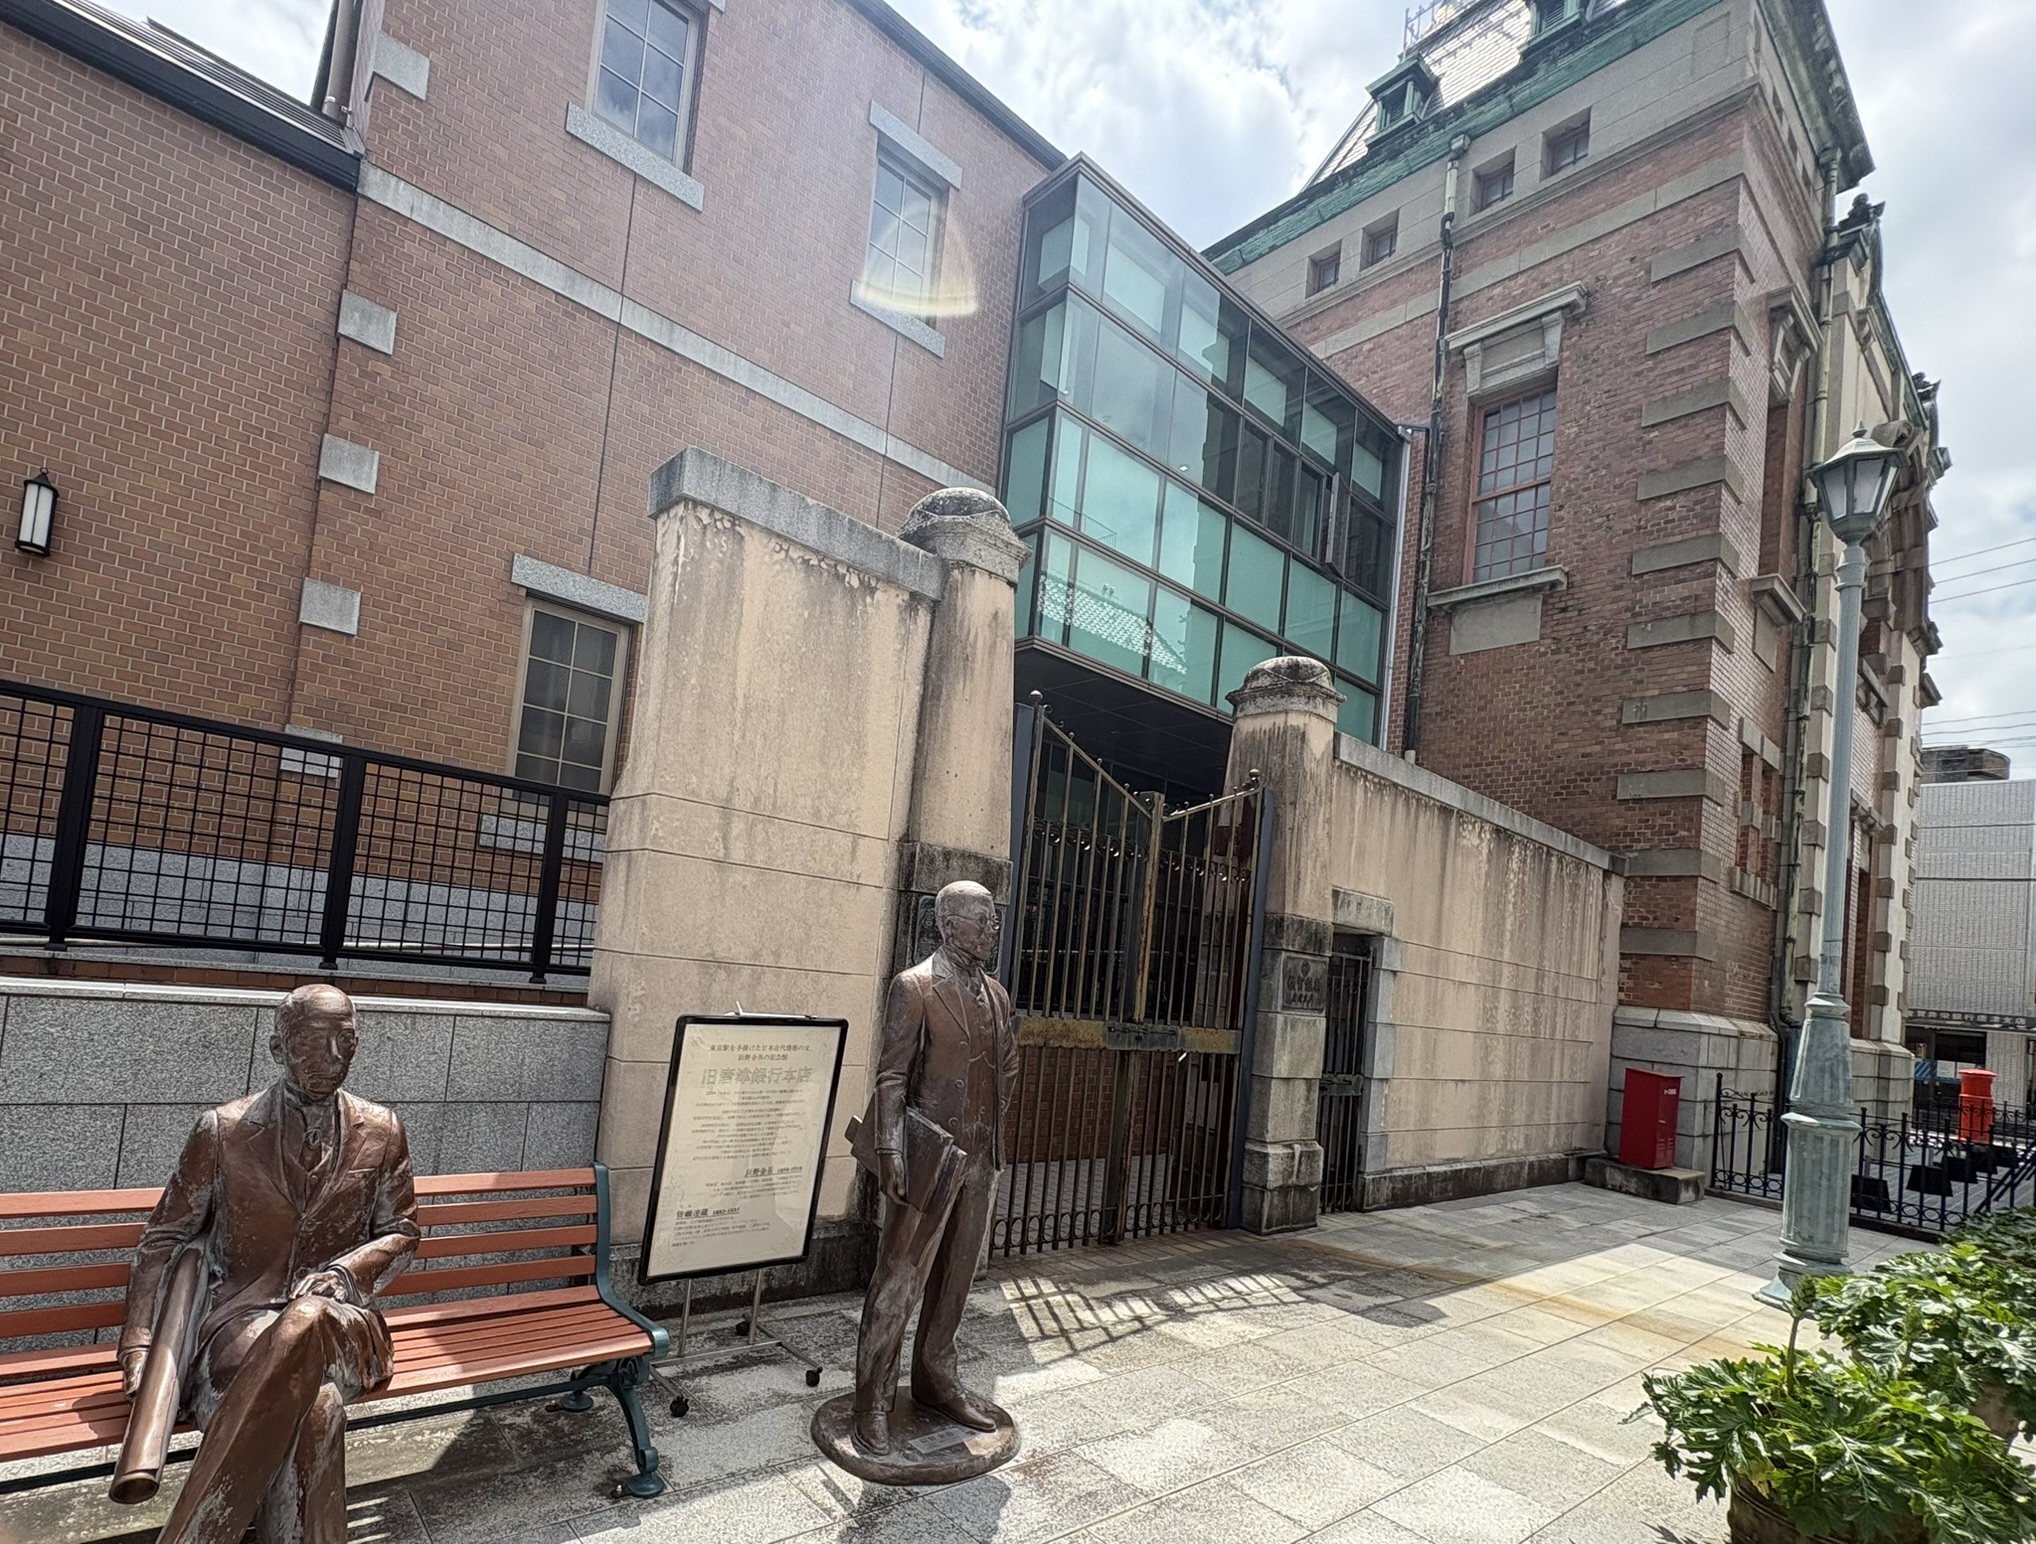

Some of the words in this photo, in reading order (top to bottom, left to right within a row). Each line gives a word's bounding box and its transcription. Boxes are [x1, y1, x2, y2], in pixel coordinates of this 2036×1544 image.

[701, 1066, 813, 1086] 旧唐津銀行本店
